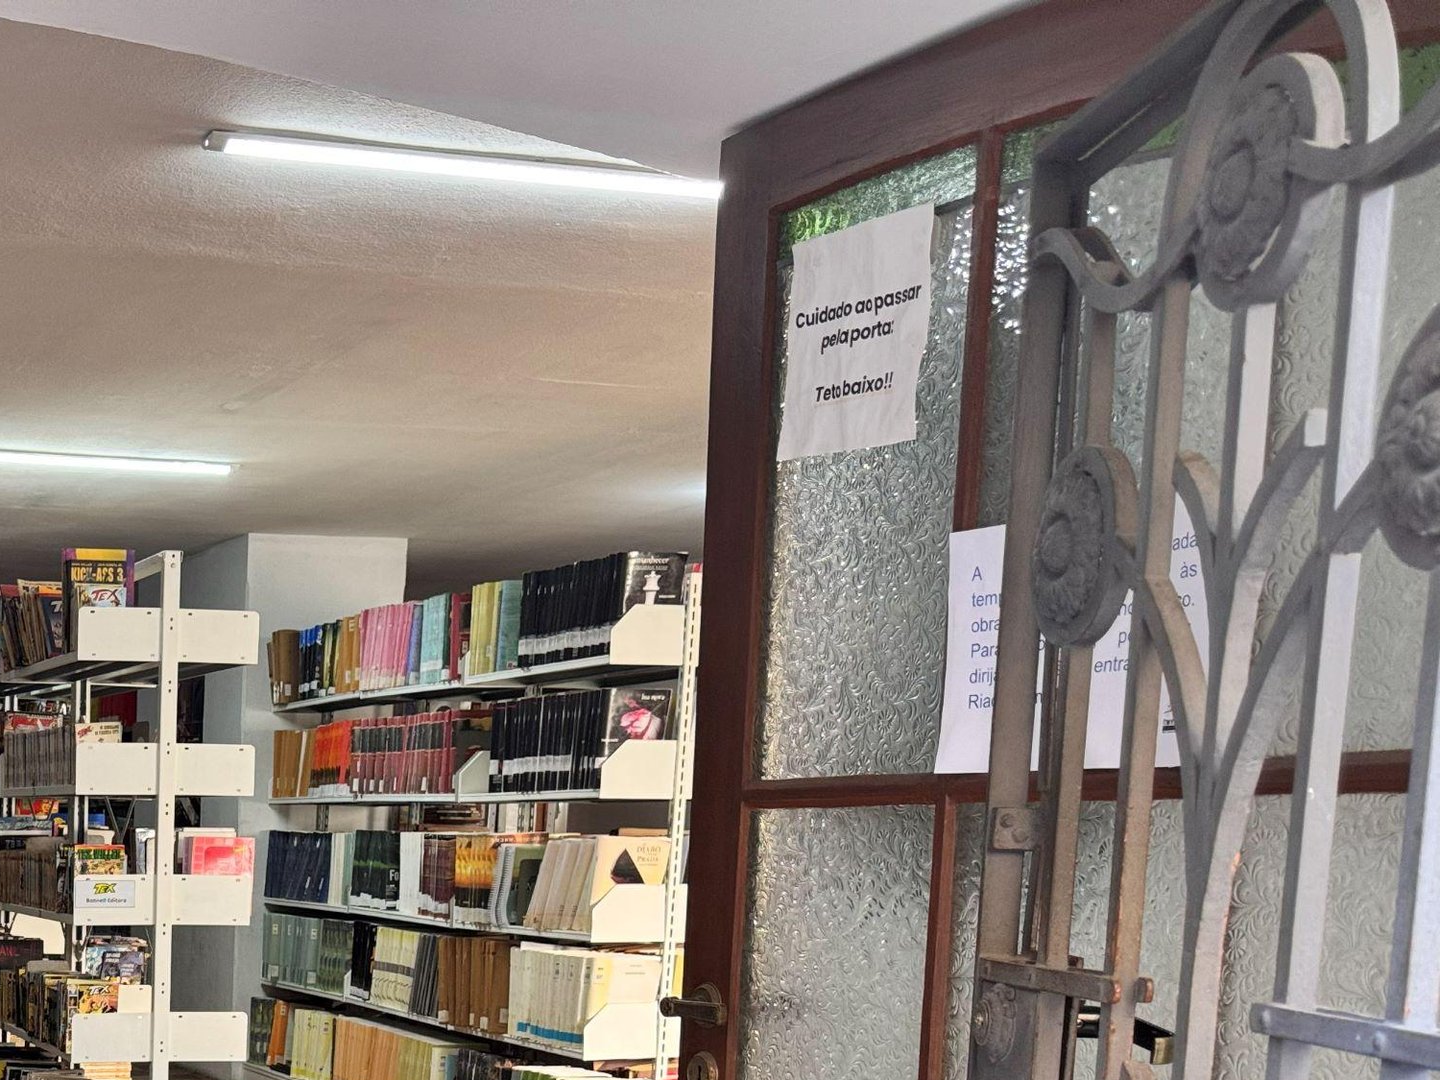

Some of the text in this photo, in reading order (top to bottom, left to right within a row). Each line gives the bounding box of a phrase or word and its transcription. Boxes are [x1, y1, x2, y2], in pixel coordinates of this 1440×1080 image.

[795, 284, 922, 328] Cuidado ao passar
[820, 329, 849, 354] pela
[815, 371, 894, 402] Teto baixo!!
[71, 567, 124, 582] KICK-ASS 3
[972, 567, 982, 582] A
[91, 588, 121, 606] TEX
[93, 883, 117, 894] TEX
